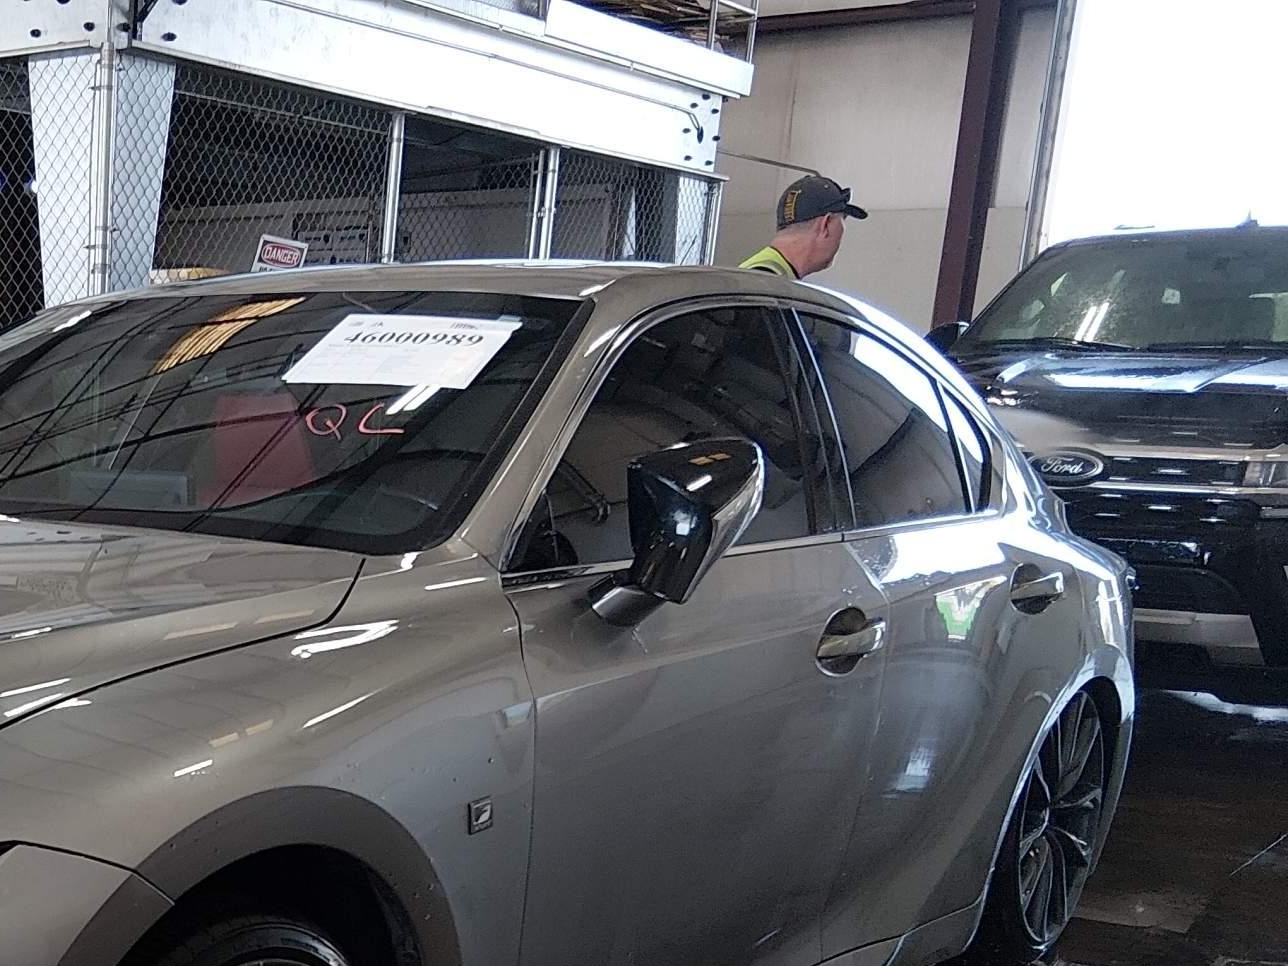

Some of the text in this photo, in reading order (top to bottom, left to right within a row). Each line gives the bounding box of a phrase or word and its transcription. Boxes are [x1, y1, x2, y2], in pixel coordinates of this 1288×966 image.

[264, 247, 299, 265] DANGER
[344, 331, 484, 346] 46000989
[1041, 457, 1083, 474] Ford
